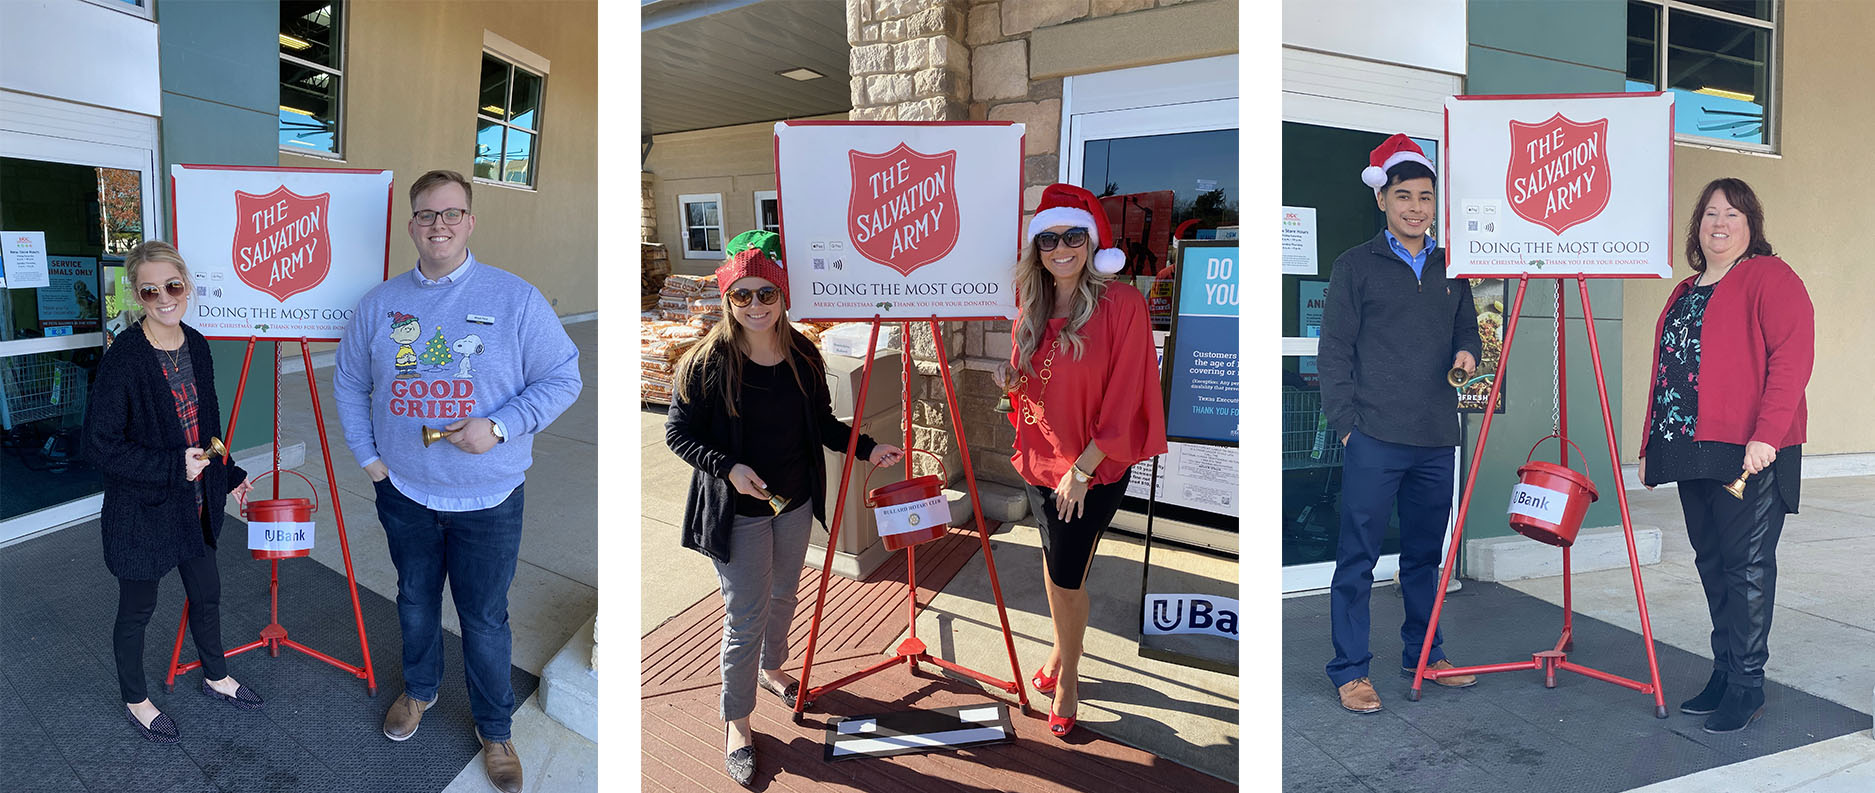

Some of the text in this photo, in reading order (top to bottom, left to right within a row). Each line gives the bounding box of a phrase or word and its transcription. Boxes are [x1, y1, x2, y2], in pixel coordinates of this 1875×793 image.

[1526, 127, 1565, 164] THE
[1513, 131, 1598, 204] SALVATION
[869, 159, 910, 199] THE
[1543, 166, 1596, 219] ARMY
[856, 165, 946, 243] SALVATION
[251, 200, 289, 234] THE
[239, 205, 320, 272] SALVATION
[890, 202, 943, 259] ARMY
[1469, 241, 1650, 254] DOING THE MOST GOOD
[51, 259, 82, 268] SERVICE
[75, 268, 94, 276] ONLY
[268, 238, 317, 288] ARMY
[1207, 258, 1233, 280] DO
[812, 281, 999, 296] DOING THE MOST GOOD
[198, 304, 353, 320] DOING THE MOST GOO
[1193, 350, 1237, 359] Customers
[1194, 359, 1208, 367] the
[1209, 360, 1224, 368] age
[1189, 367, 1225, 376] covering
[391, 379, 474, 399] GOOD
[389, 398, 476, 418] GRIEF
[1192, 405, 1239, 417] THANK YOU FO
[883, 506, 908, 515] BULLARD
[908, 501, 928, 511] ROTARY
[265, 529, 305, 542] UBank
[1153, 599, 1238, 635] UBa
